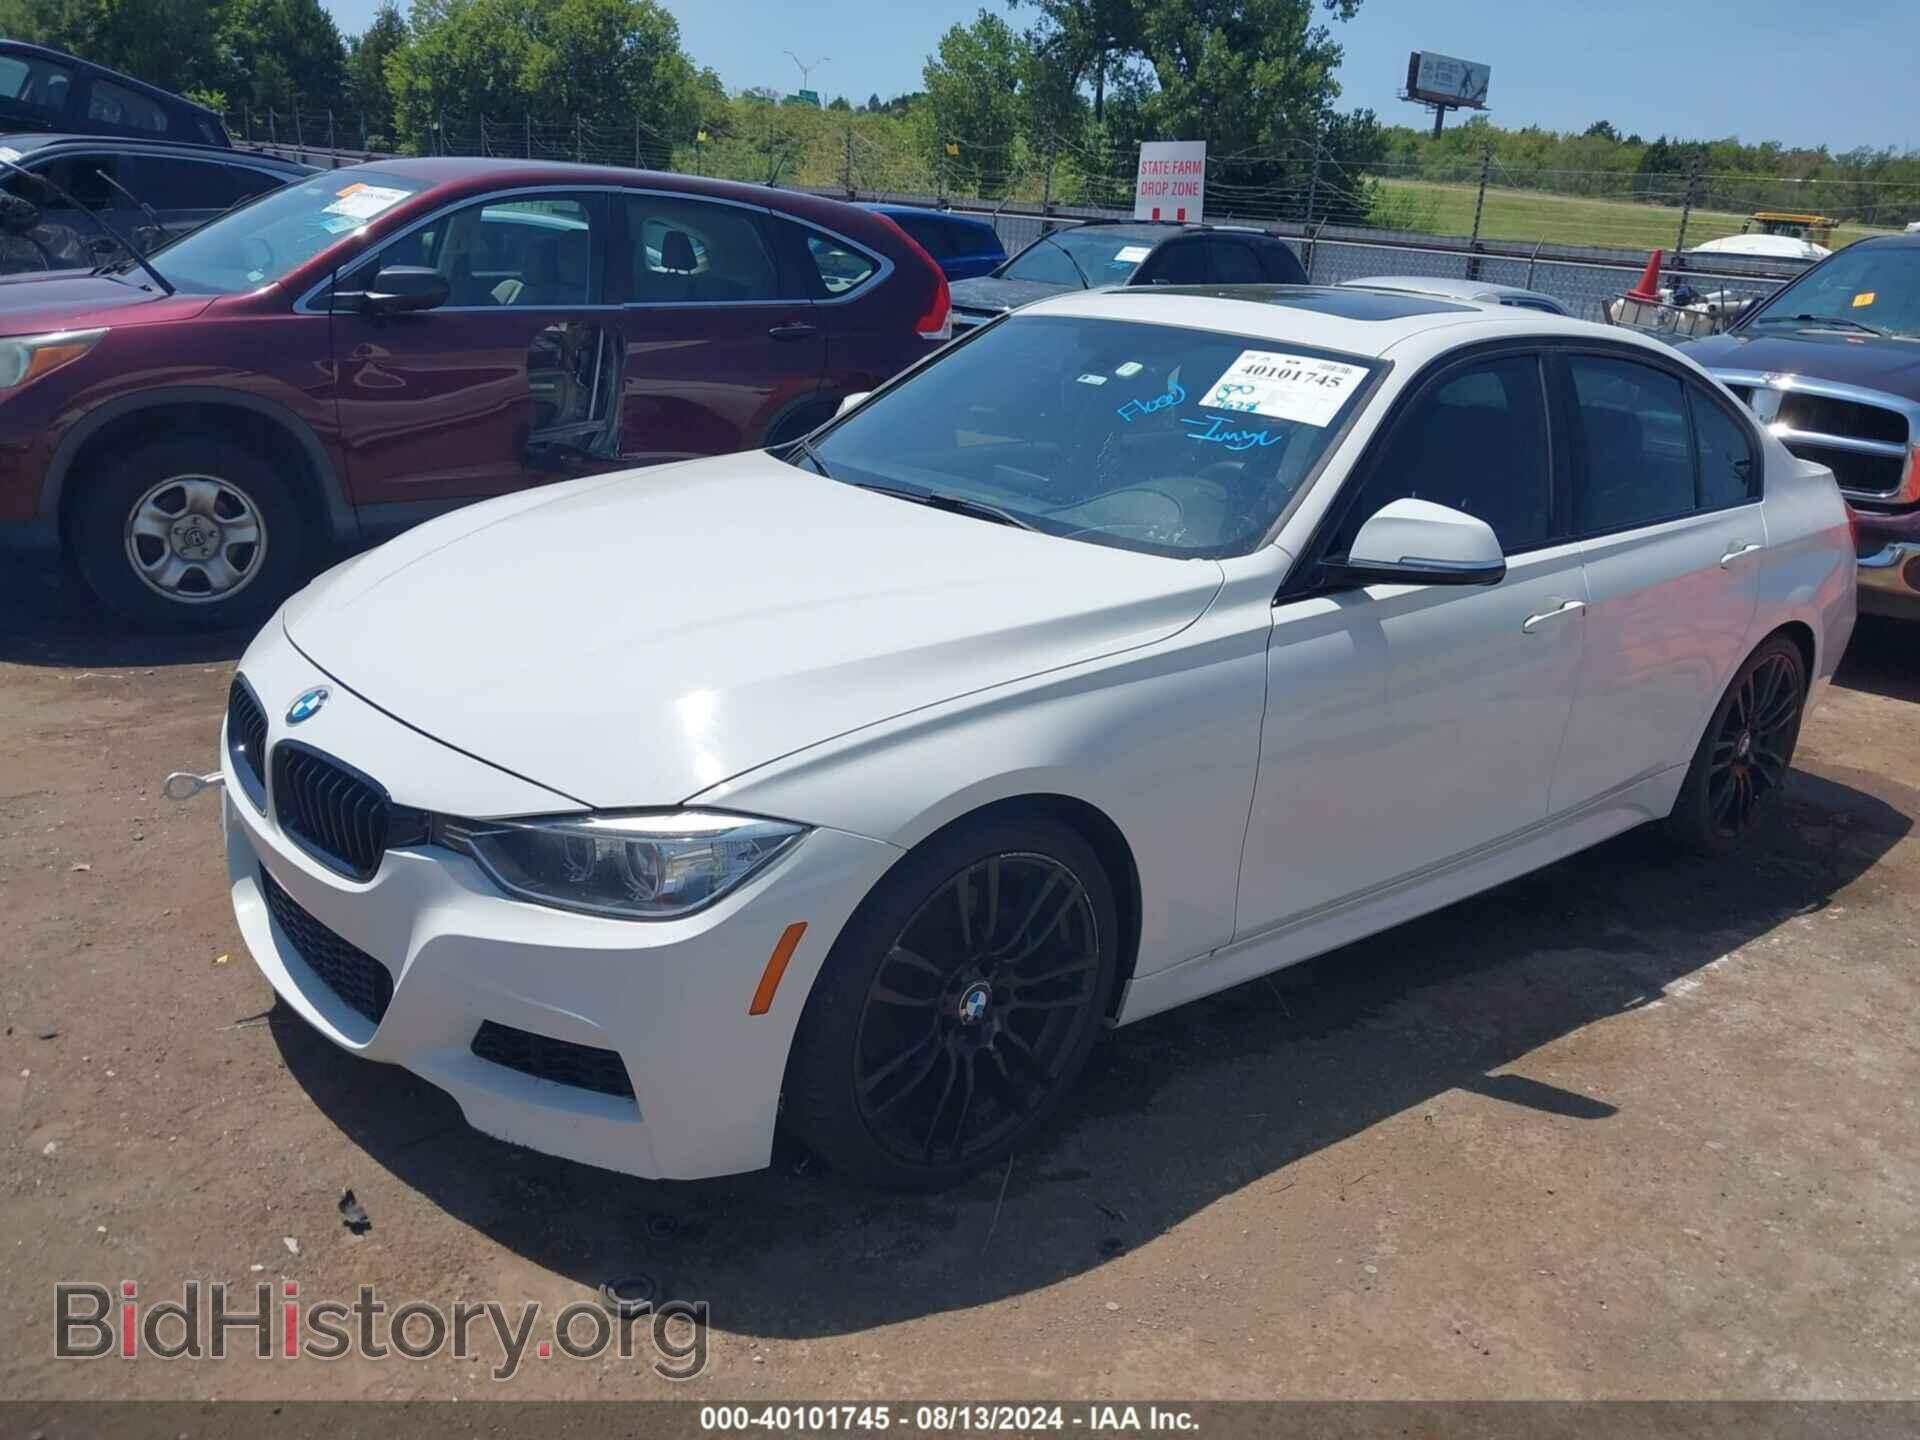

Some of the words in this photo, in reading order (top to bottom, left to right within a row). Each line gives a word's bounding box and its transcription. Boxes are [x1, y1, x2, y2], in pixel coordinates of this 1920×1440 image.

[1141, 160, 1169, 175] STATE
[1173, 160, 1202, 175] FARM
[1141, 182, 1169, 196] DROP
[1172, 182, 1199, 196] ZONE
[1241, 364, 1343, 387] 40101745
